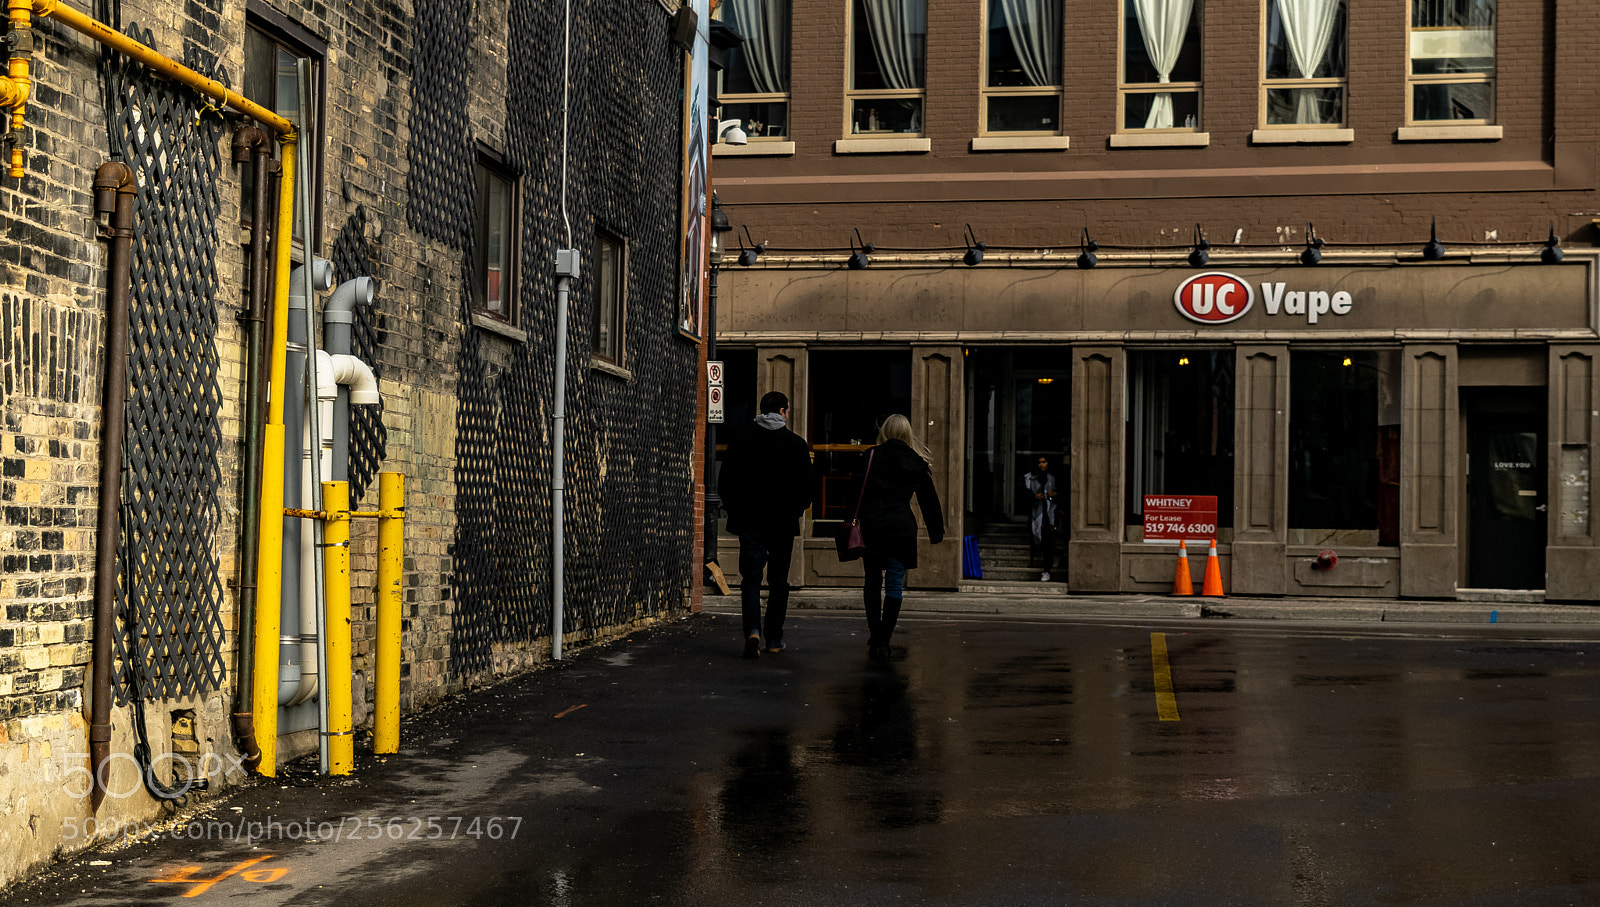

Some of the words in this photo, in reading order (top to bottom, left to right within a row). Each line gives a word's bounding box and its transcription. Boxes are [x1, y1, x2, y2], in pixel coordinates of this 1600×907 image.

[1191, 283, 1235, 315] UC
[1260, 282, 1353, 324] Vape
[1145, 498, 1193, 507] WHITNEY
[1160, 514, 1182, 522] Lease
[1145, 522, 1164, 533] 519
[1166, 523, 1186, 533] 746
[1187, 523, 1216, 534] 6300
